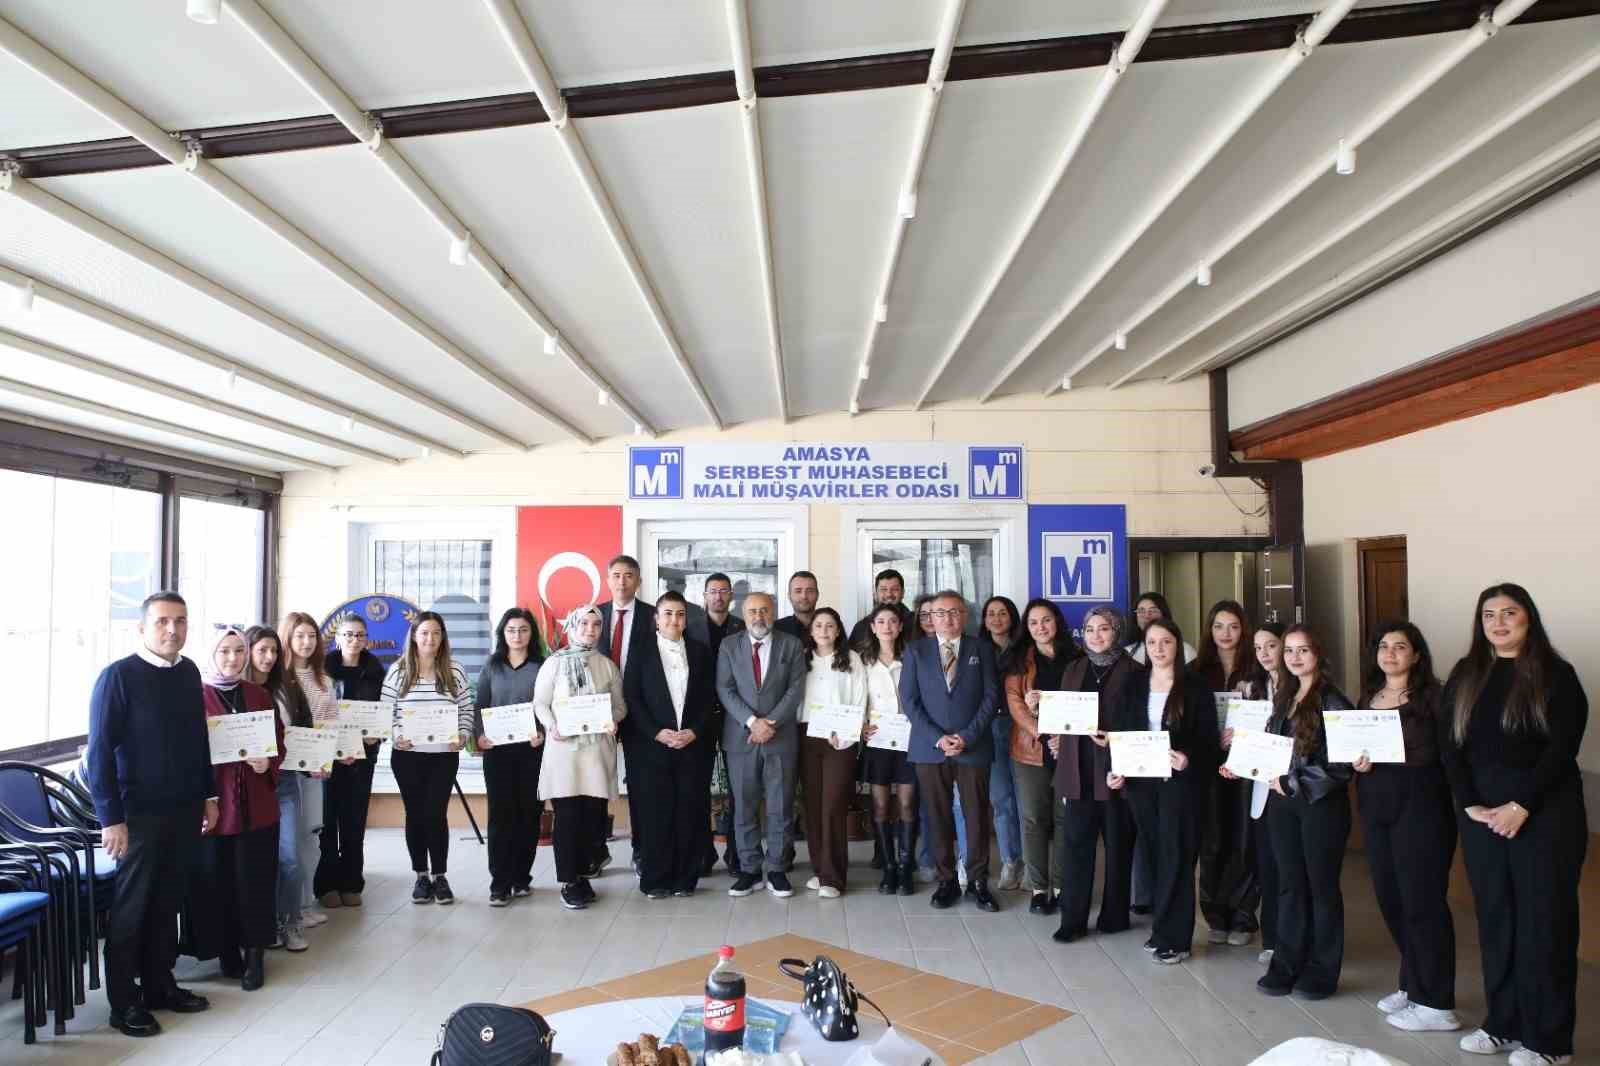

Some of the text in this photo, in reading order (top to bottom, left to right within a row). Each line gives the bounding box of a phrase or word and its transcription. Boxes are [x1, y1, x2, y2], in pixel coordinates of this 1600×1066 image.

[782, 447, 870, 461] AMASYA
[704, 462, 948, 480] SERBEST MUHASEBECİ
[693, 481, 960, 501] MALİ MÜŞAVİRLER ODASI
